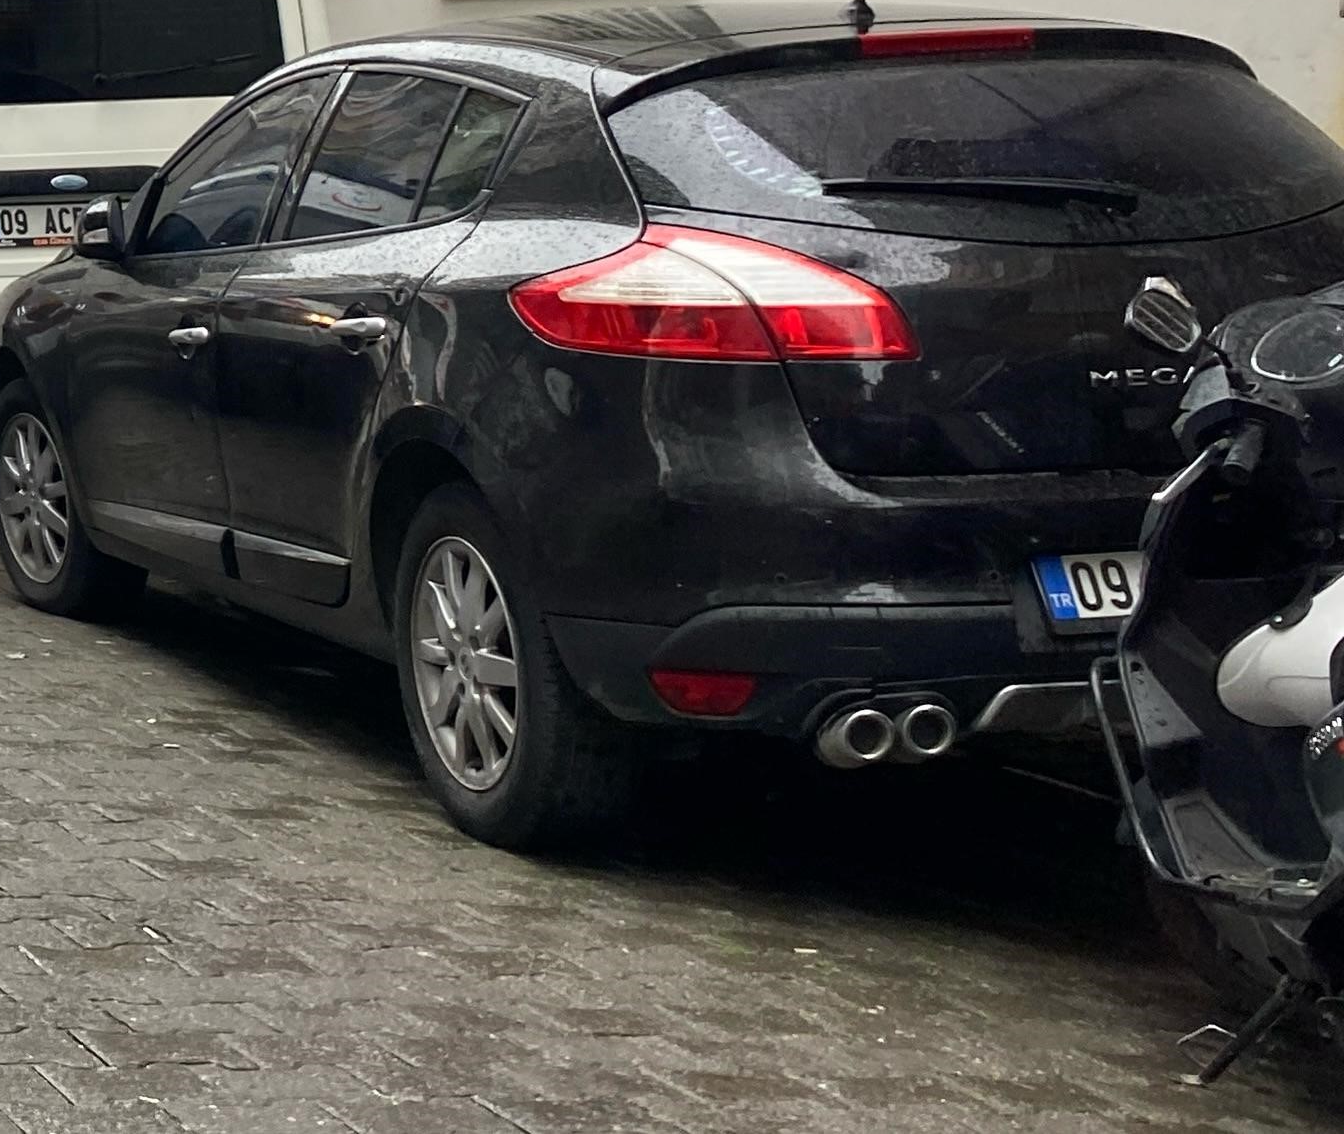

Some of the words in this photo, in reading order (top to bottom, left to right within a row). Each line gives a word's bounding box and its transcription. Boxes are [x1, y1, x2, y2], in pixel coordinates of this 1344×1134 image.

[0, 209, 28, 235] 09
[1071, 559, 1133, 612] 09
[1050, 593, 1074, 608] TR
